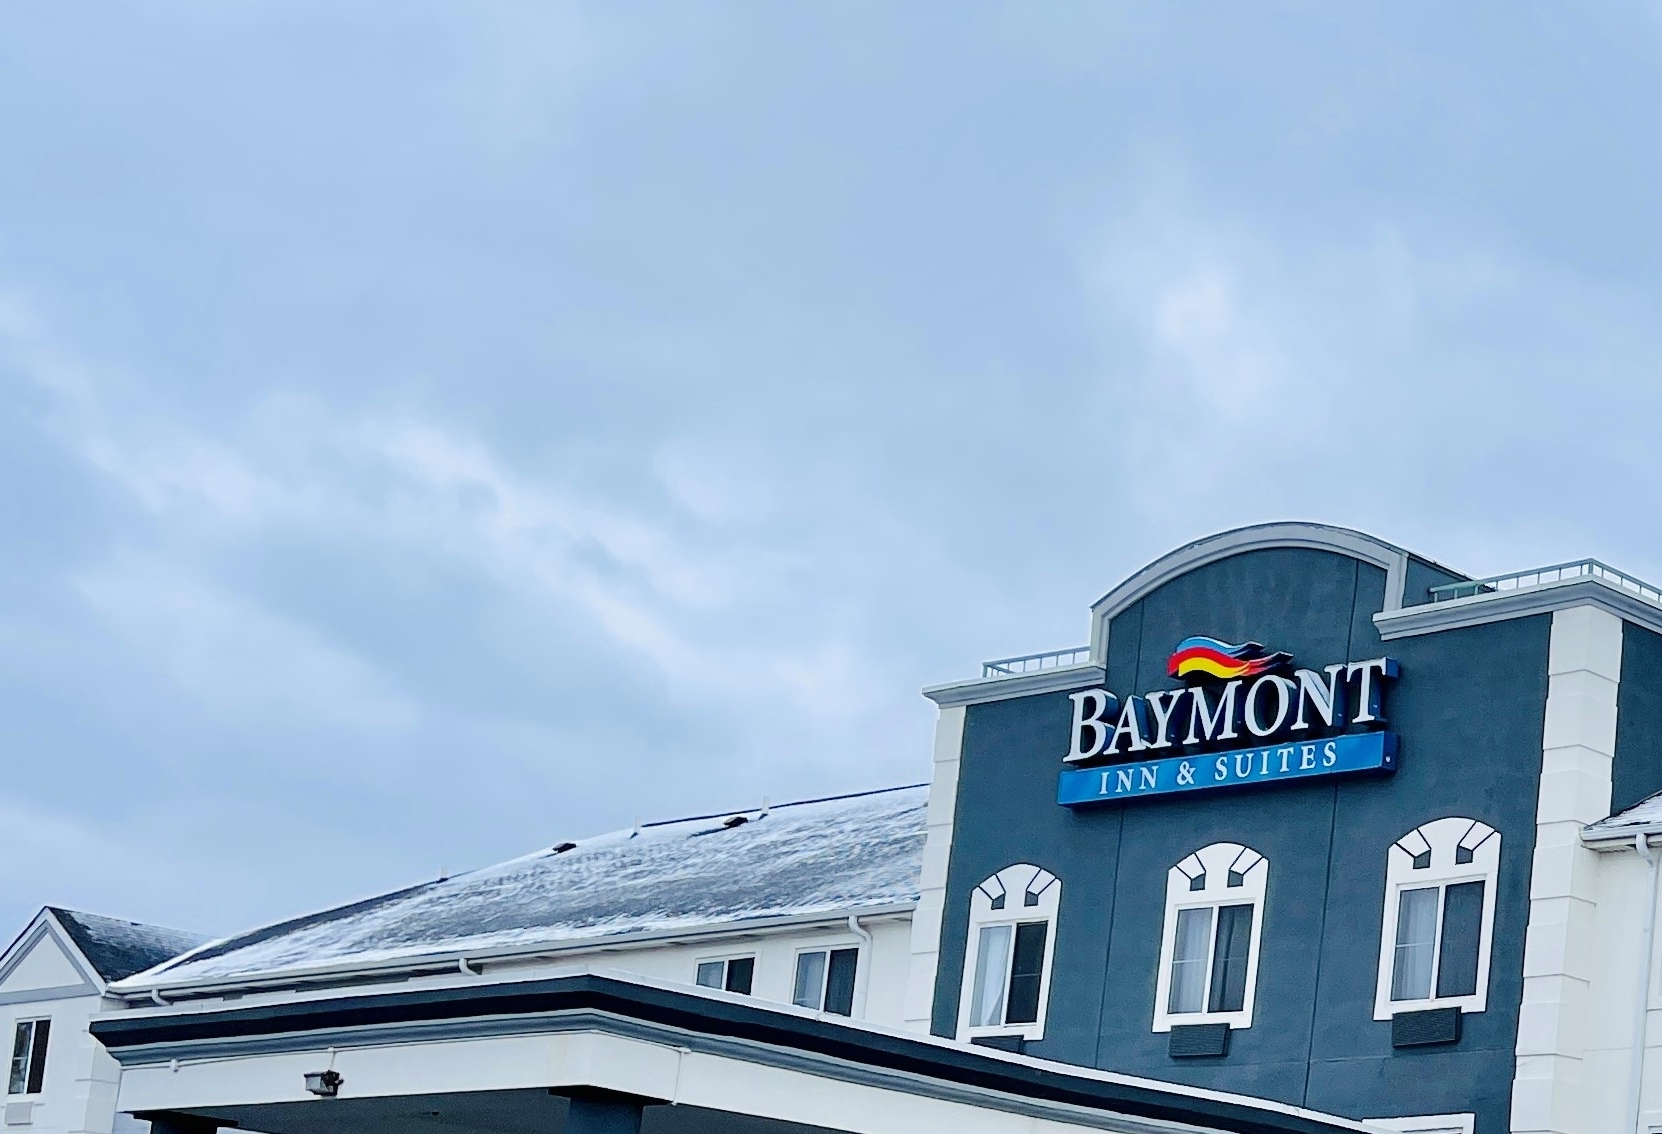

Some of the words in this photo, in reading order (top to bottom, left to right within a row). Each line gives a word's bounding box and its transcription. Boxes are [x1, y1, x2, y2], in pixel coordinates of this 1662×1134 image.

[1063, 659, 1388, 763] BAYMONT
[1099, 766, 1158, 795] INN
[1176, 761, 1196, 785] &
[1214, 741, 1337, 781] SUITES
